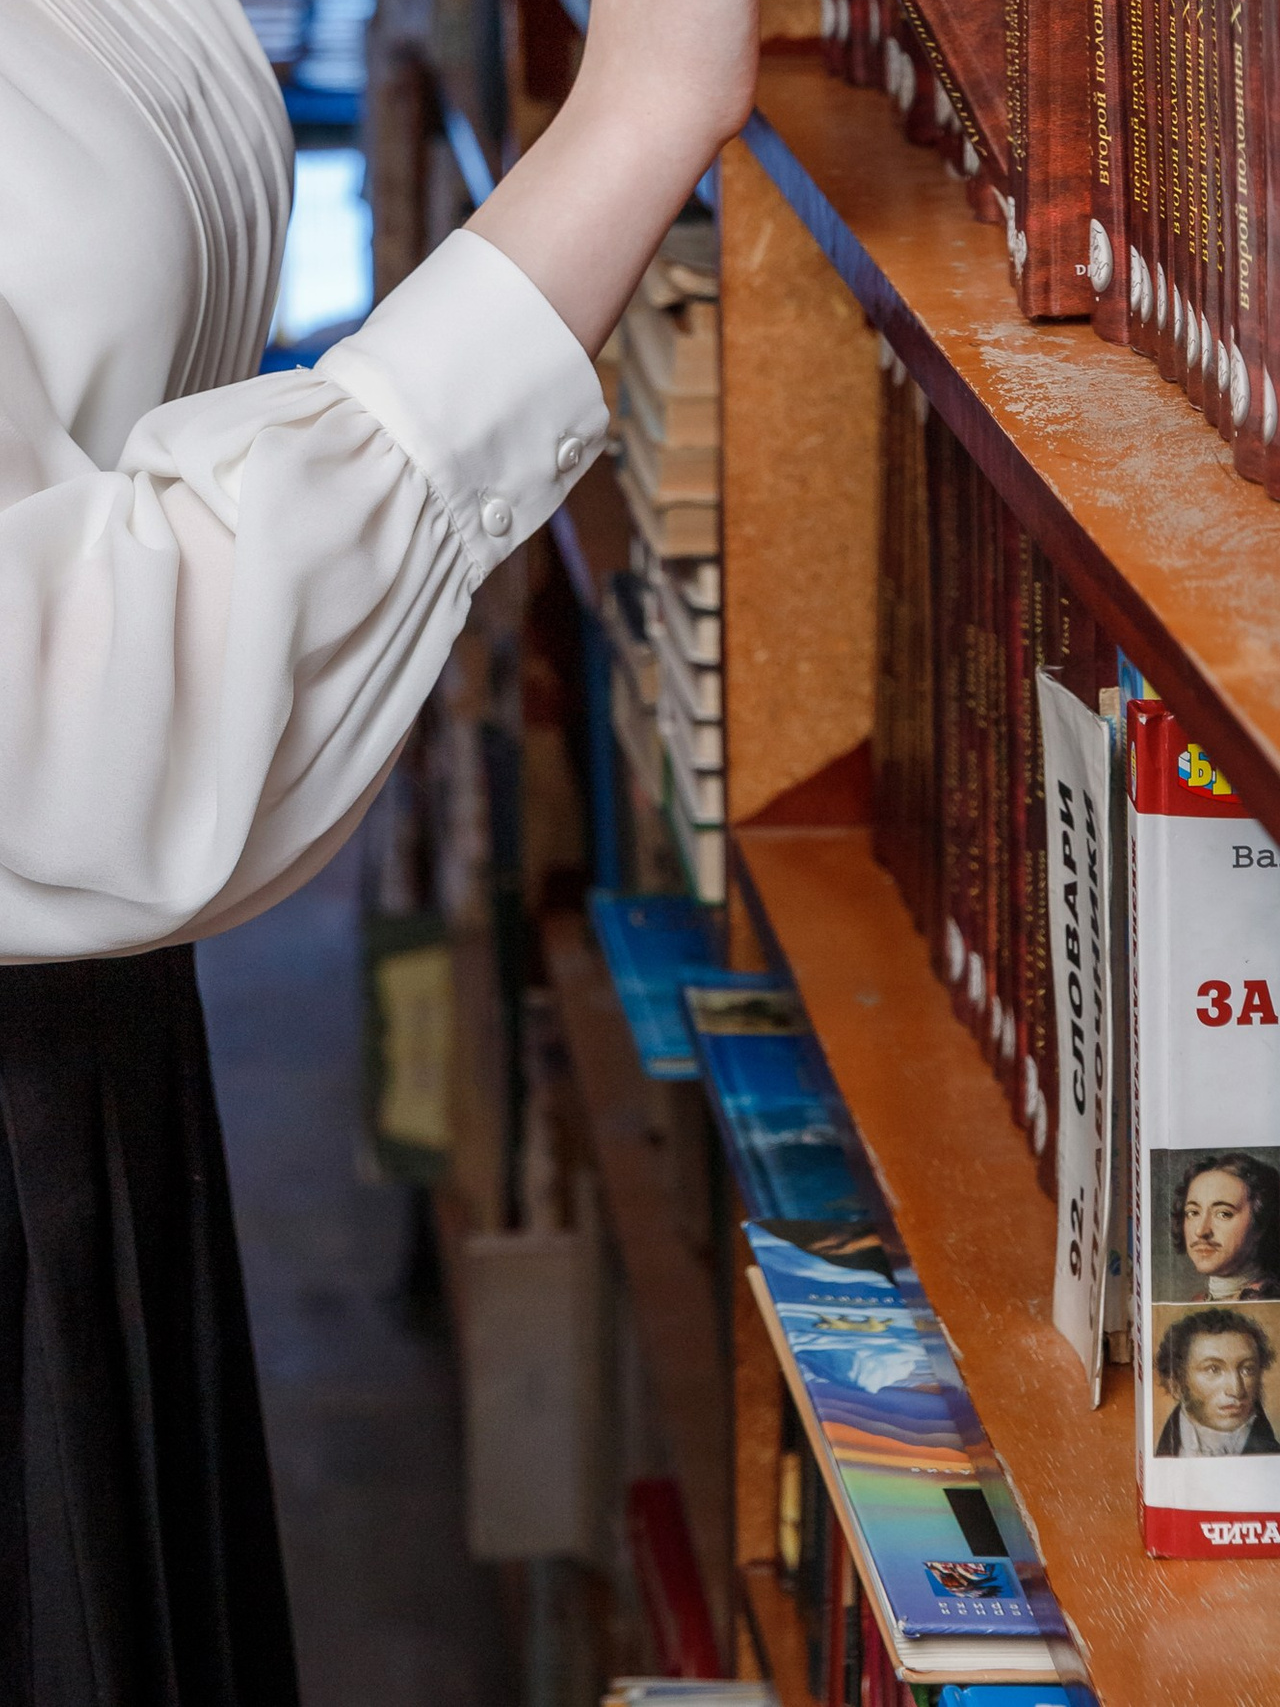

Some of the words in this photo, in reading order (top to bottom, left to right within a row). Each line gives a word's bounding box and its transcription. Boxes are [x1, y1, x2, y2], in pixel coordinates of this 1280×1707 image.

[1169, 15, 1179, 141] половины
[1185, 31, 1194, 159] половины
[1198, 36, 1207, 166] половины
[1233, 43, 1247, 194] половины
[1093, 90, 1112, 186] второй
[1139, 127, 1150, 212] первой
[1171, 148, 1182, 235] второй
[1187, 166, 1198, 254] второй
[1198, 171, 1210, 265] второй
[1235, 202, 1252, 310] второй
[1232, 845, 1280, 869] Ва
[1058, 779, 1086, 1117] СЛОВАРИ
[1196, 979, 1279, 1028] ЗА
[1083, 789, 1103, 1332] СПРАВОЧНИКИ
[1069, 1185, 1085, 1282] 92.
[1200, 1521, 1280, 1545] ЧИТА
